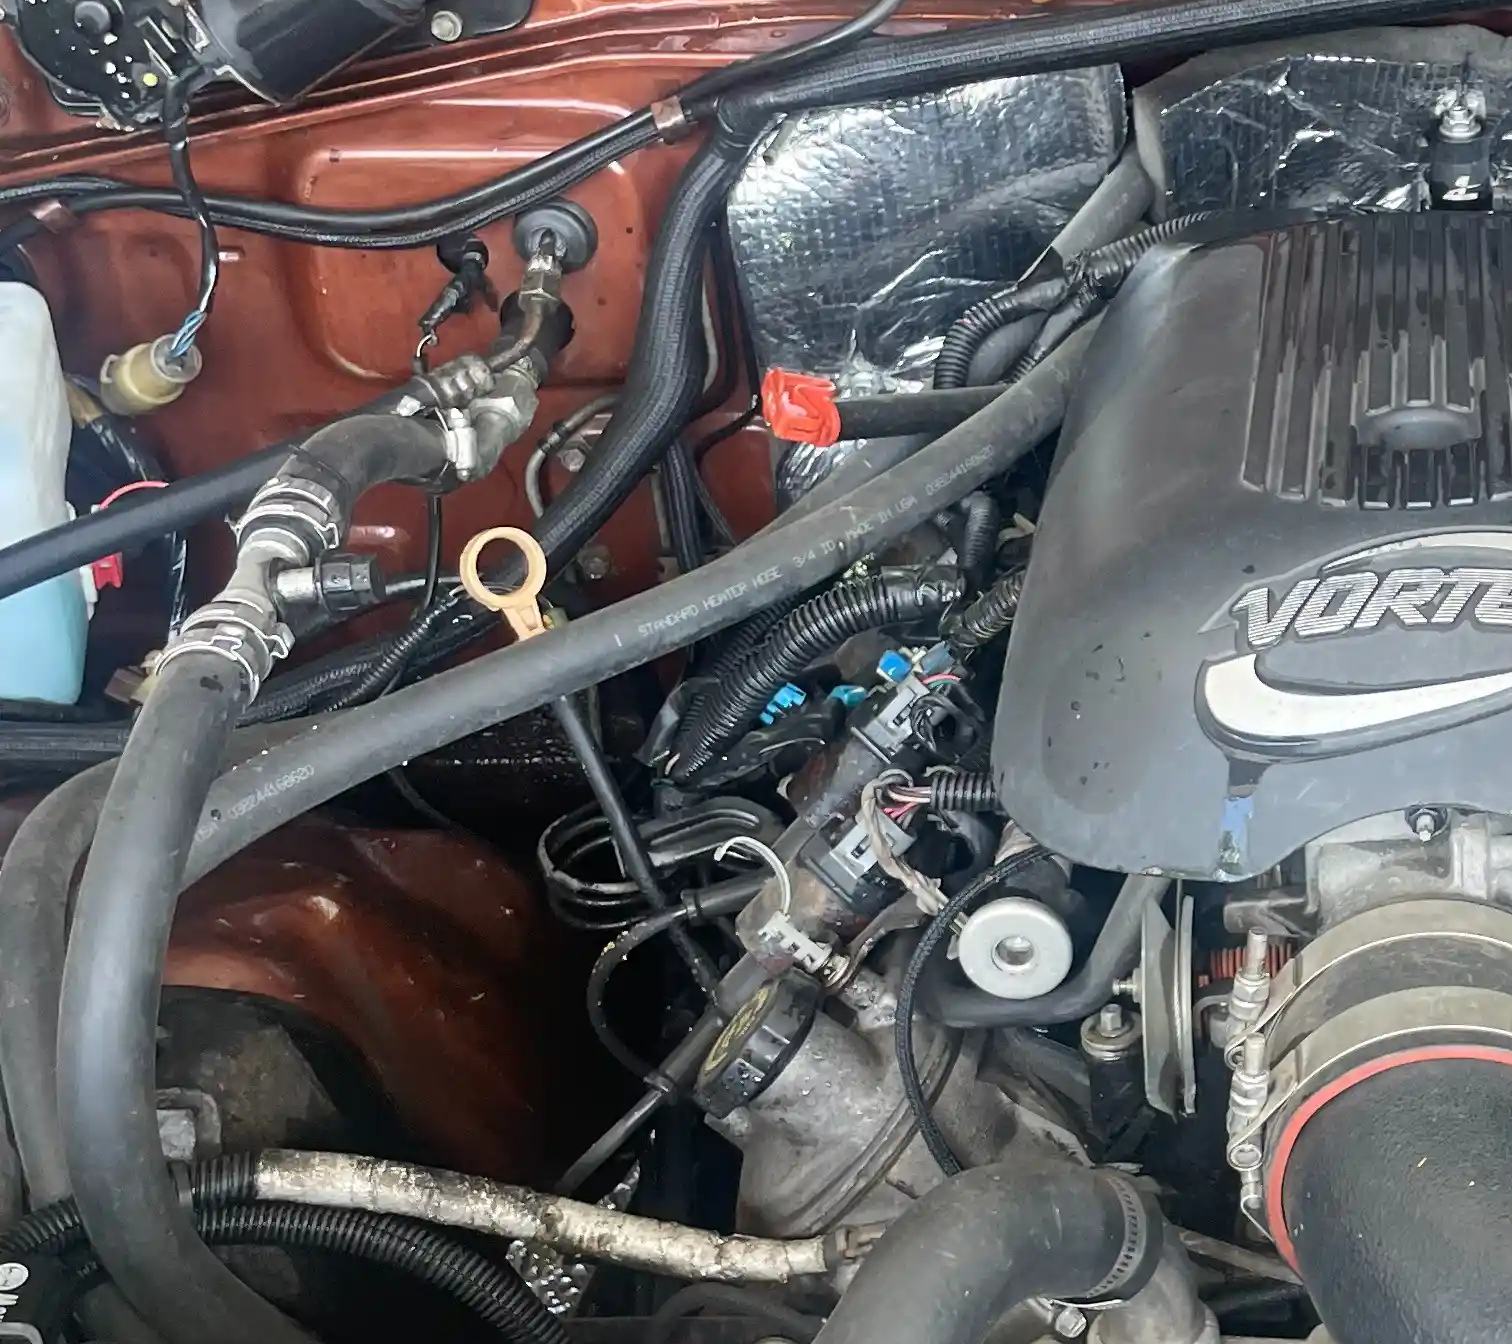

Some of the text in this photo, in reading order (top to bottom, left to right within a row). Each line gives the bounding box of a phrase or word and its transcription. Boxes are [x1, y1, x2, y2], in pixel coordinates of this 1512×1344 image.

[638, 604, 699, 637] STANDARD
[702, 582, 748, 610] HEATER
[752, 565, 783, 588] HOSE
[792, 549, 816, 568] 3/4
[845, 520, 874, 542] MADE
[878, 510, 893, 525] IN
[895, 494, 918, 514] USA
